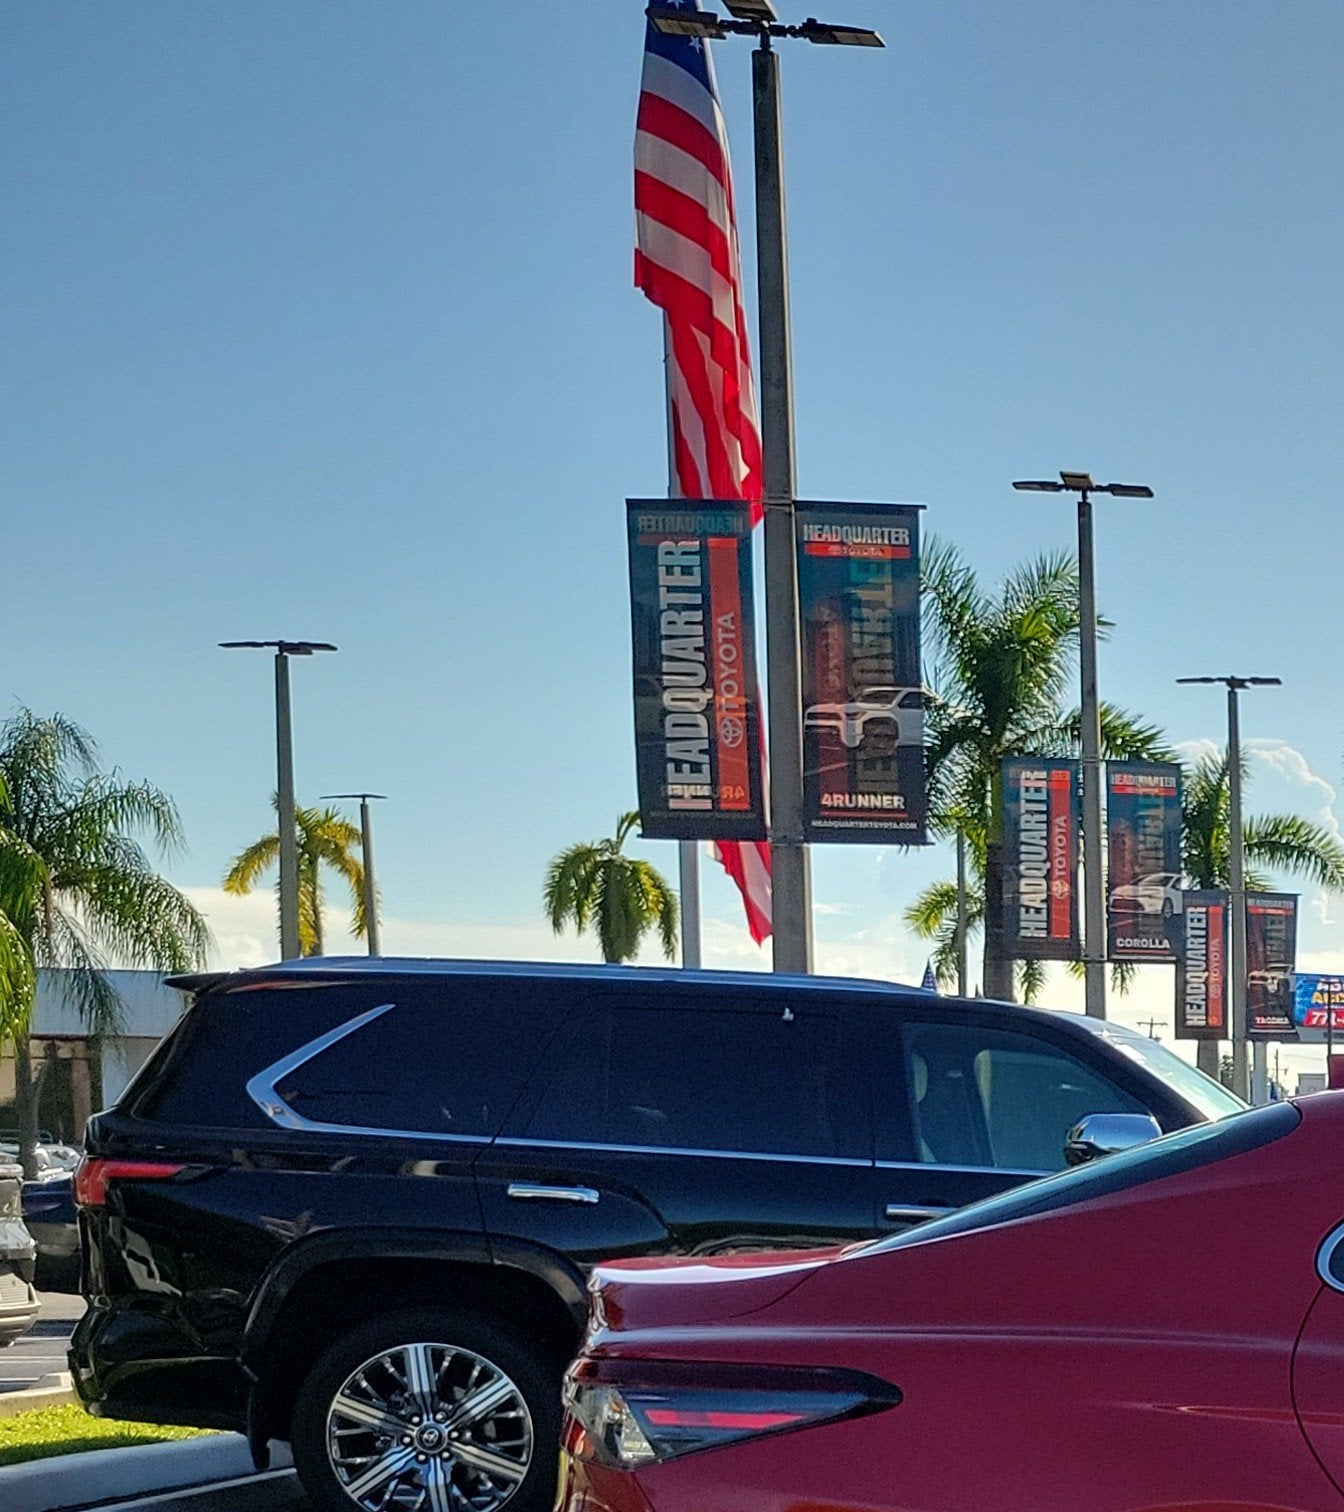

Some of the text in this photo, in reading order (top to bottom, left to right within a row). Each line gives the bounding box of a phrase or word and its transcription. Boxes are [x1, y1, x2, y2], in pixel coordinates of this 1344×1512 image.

[803, 524, 910, 546] HEADQUARTER
[658, 540, 714, 809] HEADQUARTER
[718, 611, 739, 713] TOYOTA
[821, 792, 905, 809] 4RUNNER
[1018, 770, 1050, 938] HEADQUARTER
[1054, 816, 1068, 877] TOYOTA
[1115, 938, 1171, 949] COROLLA
[1185, 906, 1209, 1026] HEADQUARTER
